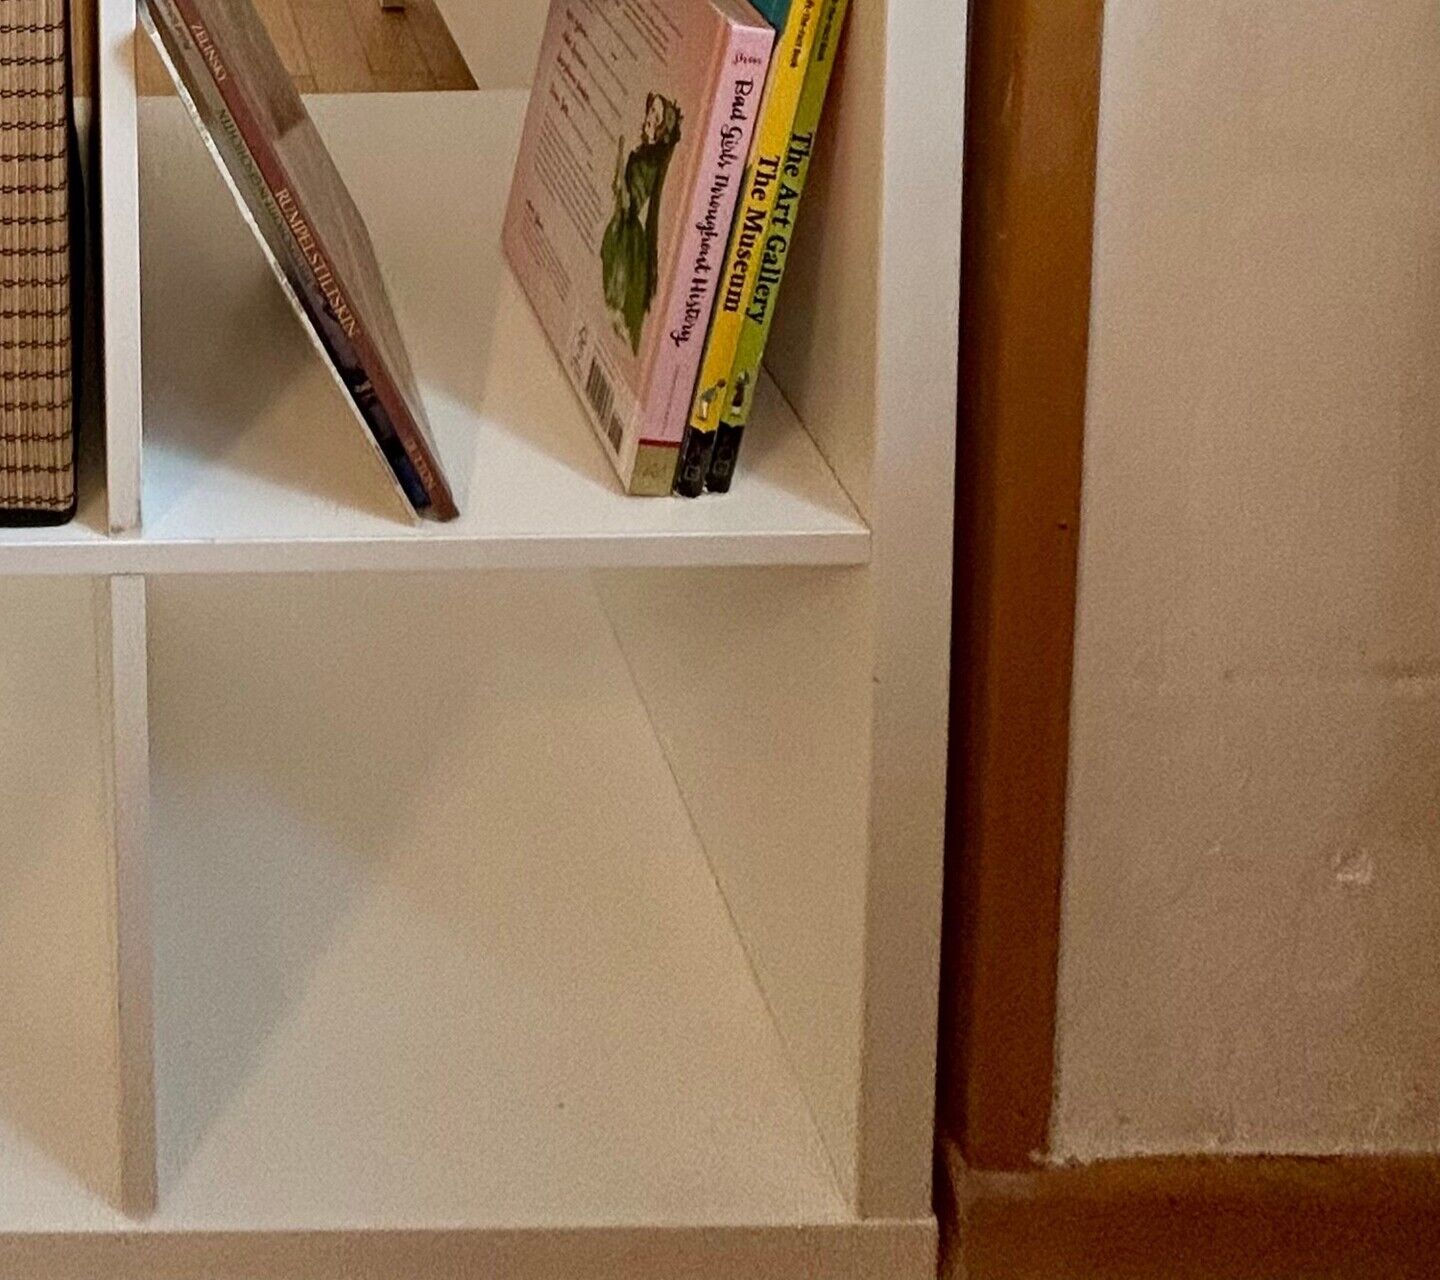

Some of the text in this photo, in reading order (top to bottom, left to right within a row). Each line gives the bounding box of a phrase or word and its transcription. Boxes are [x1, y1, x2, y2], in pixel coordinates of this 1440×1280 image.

[189, 21, 228, 82] ZELINSKY
[728, 75, 754, 122] Bad
[713, 123, 745, 172] Girls
[686, 173, 730, 275] Throughout
[723, 152, 779, 314] The Museum
[743, 129, 813, 325] The Art Gallery
[668, 276, 709, 349] History
